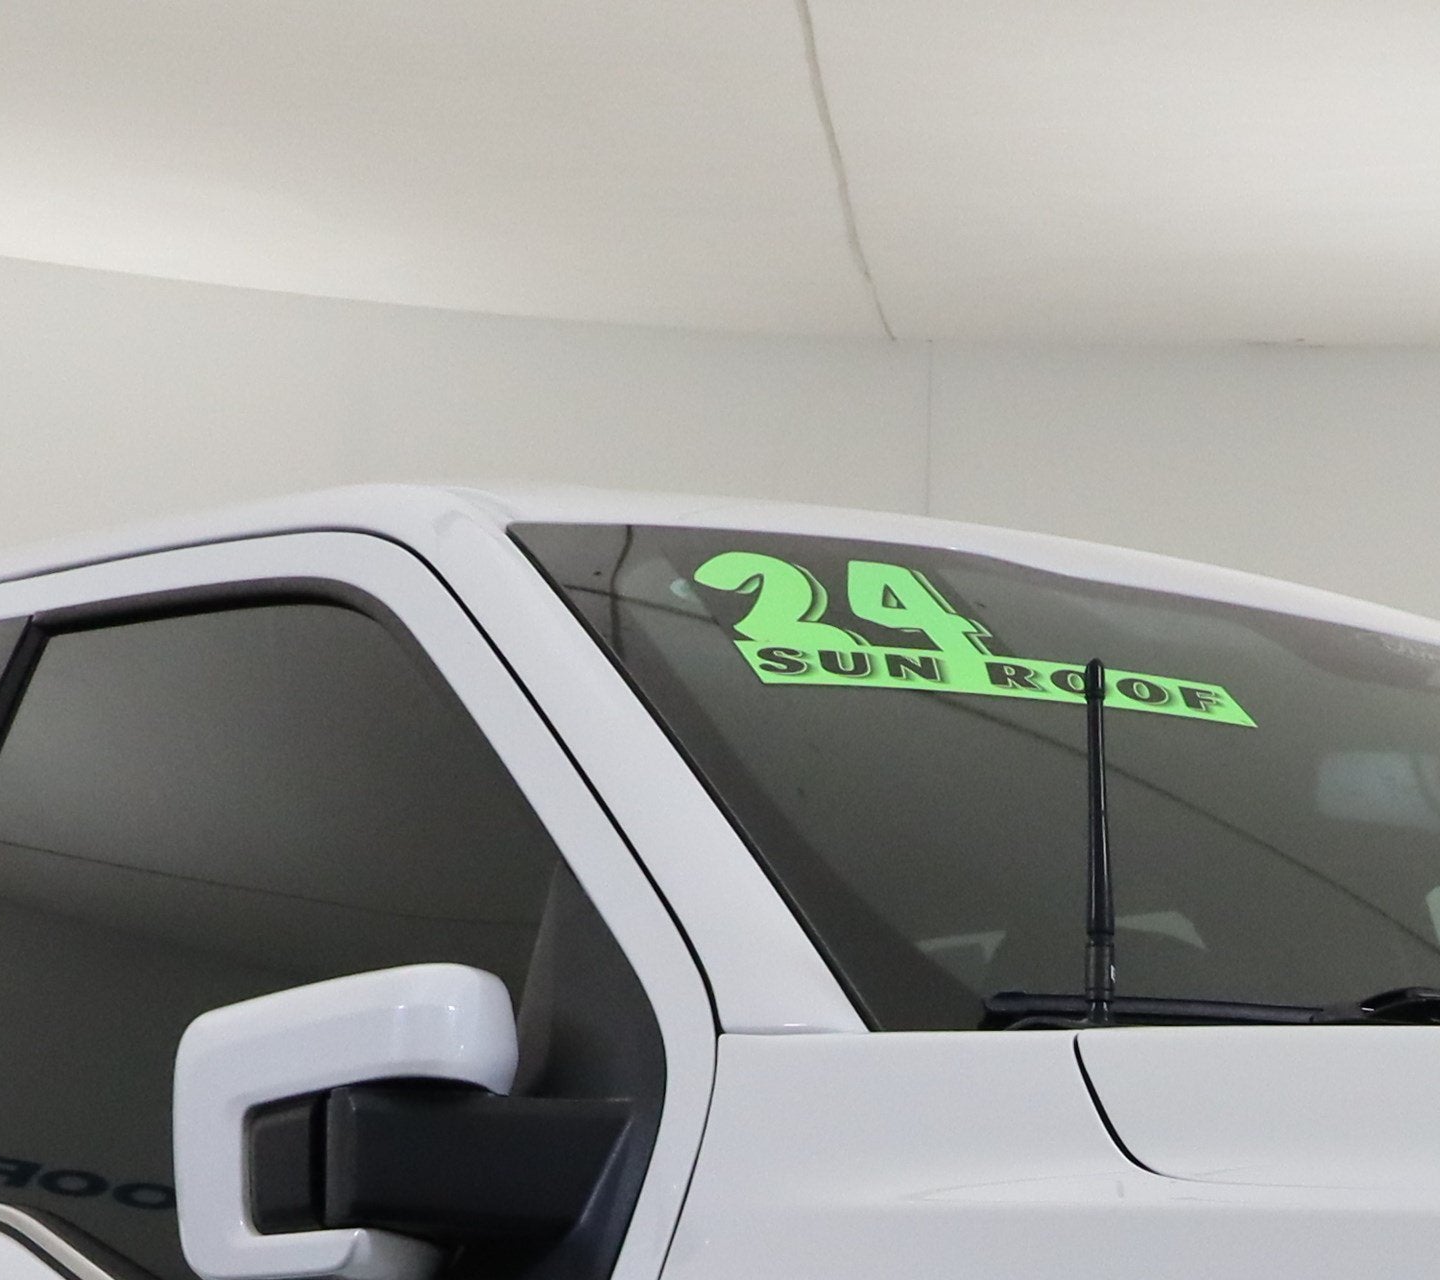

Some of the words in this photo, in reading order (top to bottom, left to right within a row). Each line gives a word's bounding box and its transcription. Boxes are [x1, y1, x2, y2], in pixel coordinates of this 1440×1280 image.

[693, 551, 992, 655] 24
[756, 645, 943, 683] SUN
[986, 660, 1225, 713] ROOF
